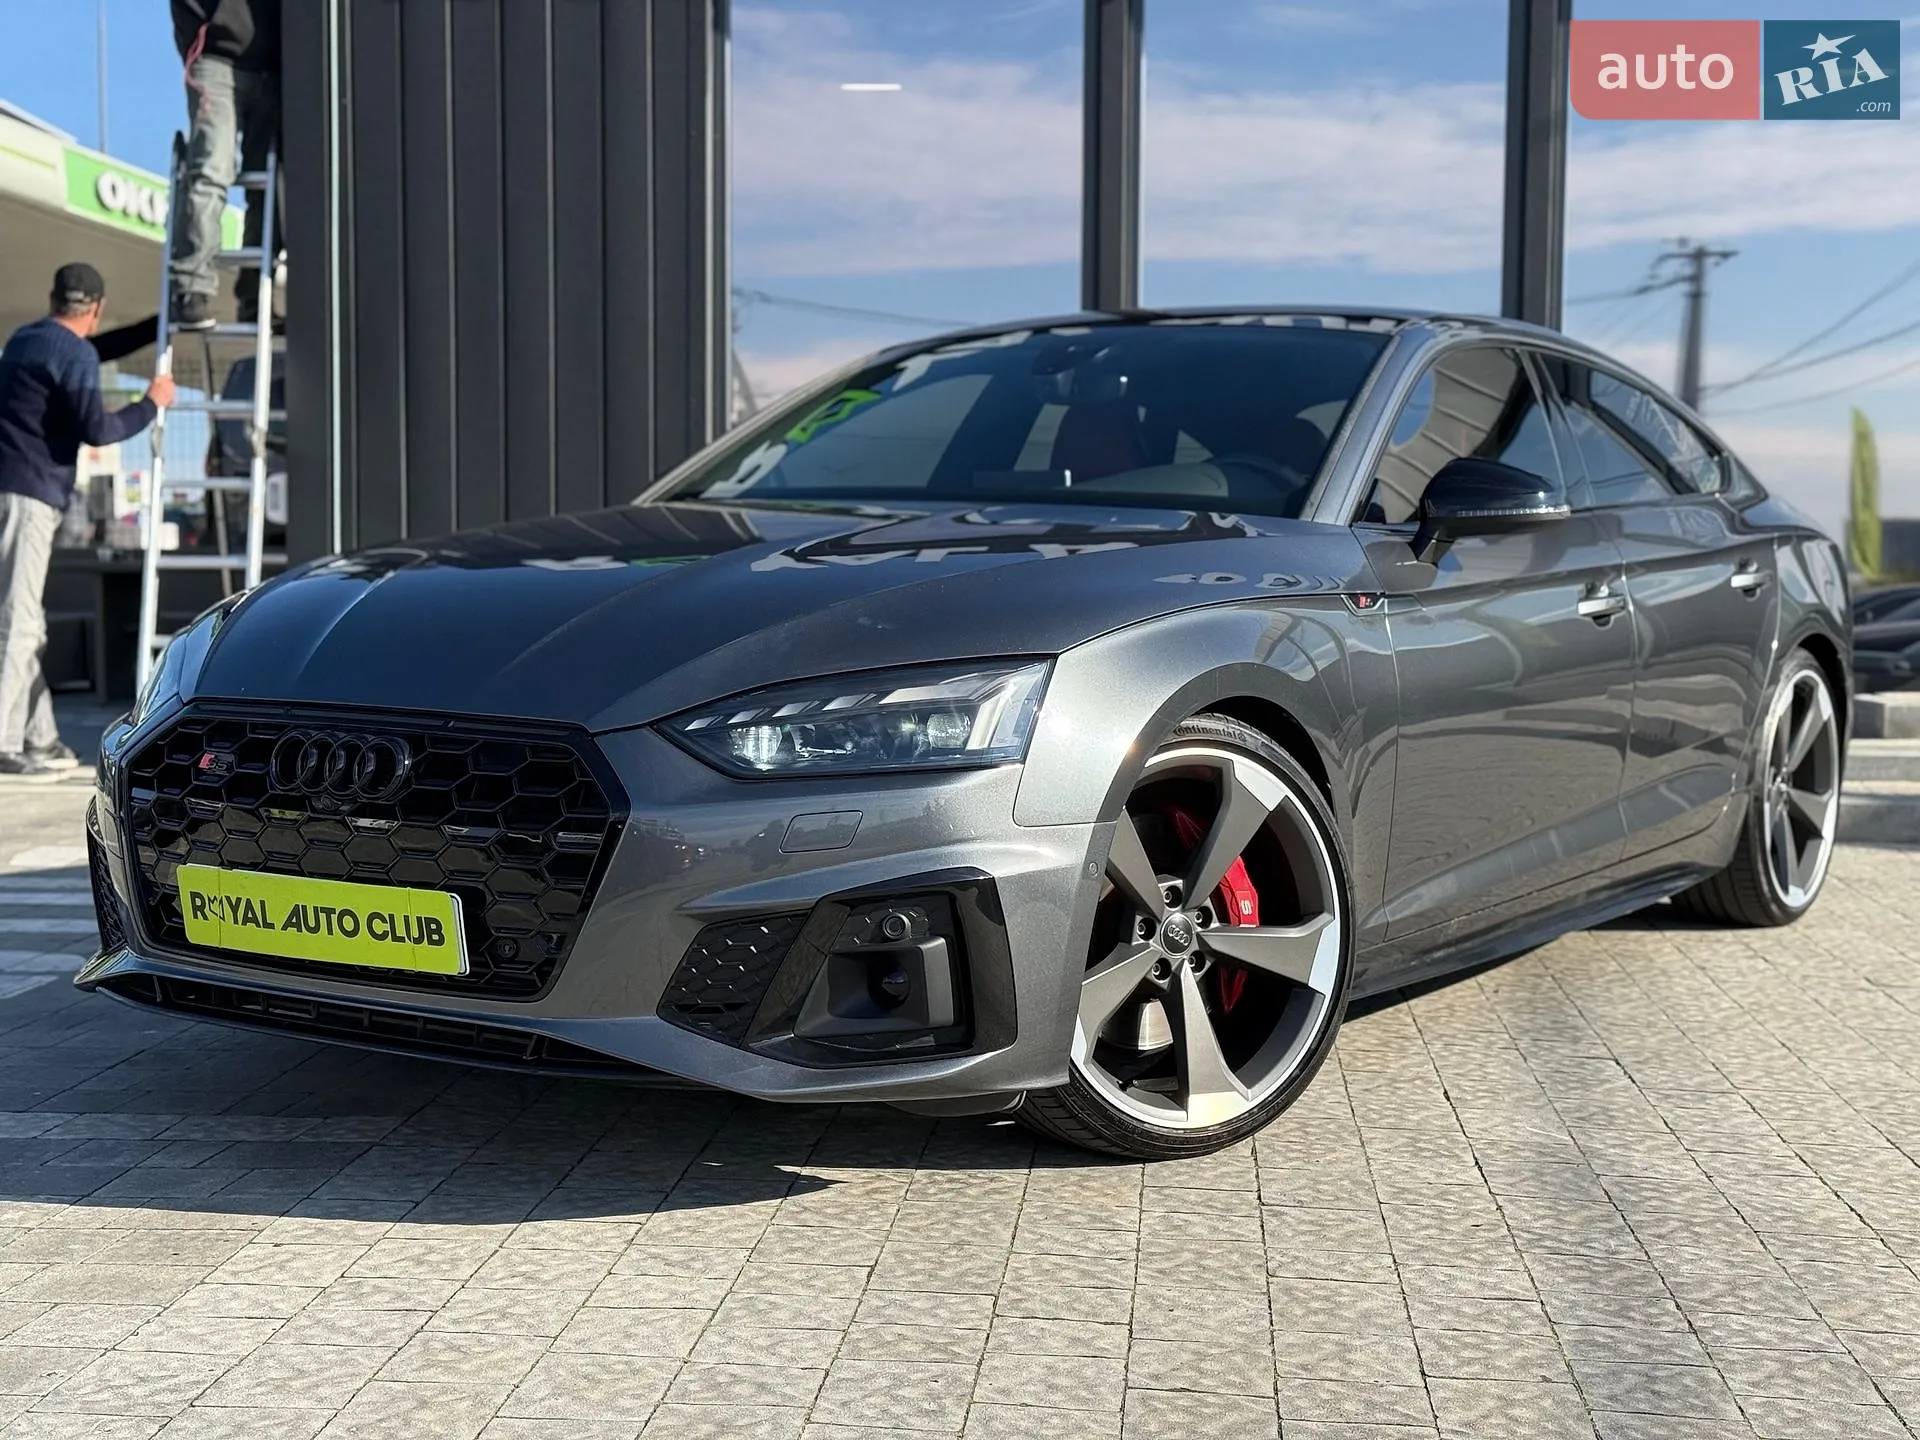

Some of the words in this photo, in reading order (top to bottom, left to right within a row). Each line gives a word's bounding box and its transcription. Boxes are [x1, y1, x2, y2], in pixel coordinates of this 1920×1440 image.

[1173, 724, 1236, 740] Continental
[281, 903, 361, 939] AUTO
[366, 911, 447, 948] CLUB
